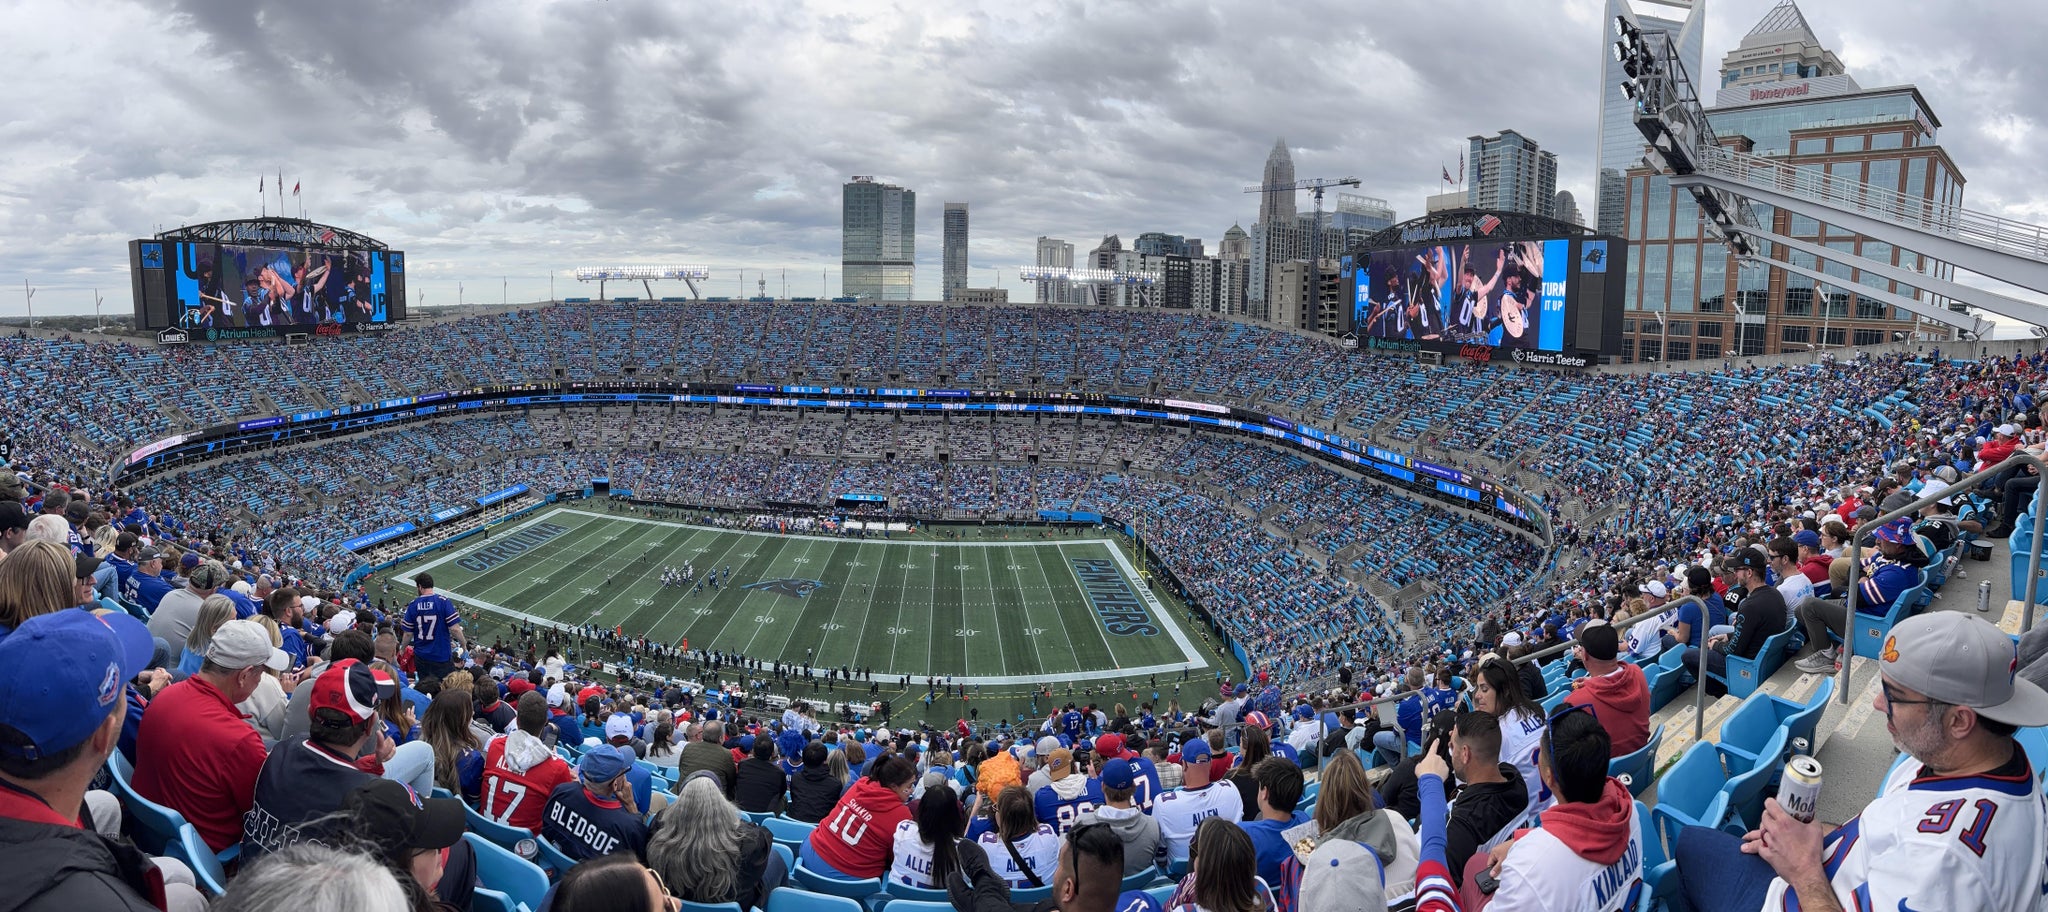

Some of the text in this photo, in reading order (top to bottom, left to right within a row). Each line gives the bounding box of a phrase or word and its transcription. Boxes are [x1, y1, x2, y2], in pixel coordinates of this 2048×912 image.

[1750, 83, 1809, 100] Honeywell
[1434, 221, 1472, 239] America
[1542, 281, 1566, 297] TURN
[1544, 300, 1563, 311] IT UP
[160, 333, 187, 343] LOWE'S
[220, 328, 277, 340] Atrium Health
[1377, 339, 1422, 352] Atrium Health
[1526, 351, 1587, 367] Harris Teeter
[354, 539, 367, 547] BANK
[375, 530, 397, 540] AMERICA
[456, 522, 570, 572] CAROLINA
[1070, 557, 1159, 637] PANTHERS
[1725, 592, 1740, 604] 89
[416, 601, 434, 611] ALLEN
[416, 615, 438, 641] 17
[754, 615, 775, 625] 50
[819, 622, 840, 631] 40
[887, 626, 907, 635] 30
[955, 627, 975, 637] 20
[1024, 627, 1042, 636] 10
[1870, 629, 1880, 637] 32
[1071, 720, 1079, 730] 17
[1519, 714, 1545, 736] ALLE
[1311, 732, 1321, 741] ALLE
[484, 775, 526, 826] 17
[848, 798, 873, 822] SHAKIR
[243, 801, 331, 854] BILL
[550, 800, 620, 856] BLEDSOE
[828, 805, 868, 846] 10
[1918, 798, 1998, 857] 91
[905, 854, 933, 875] ALLE
[1006, 855, 1036, 873] ALEN
[1592, 838, 1639, 905] KINCAID
